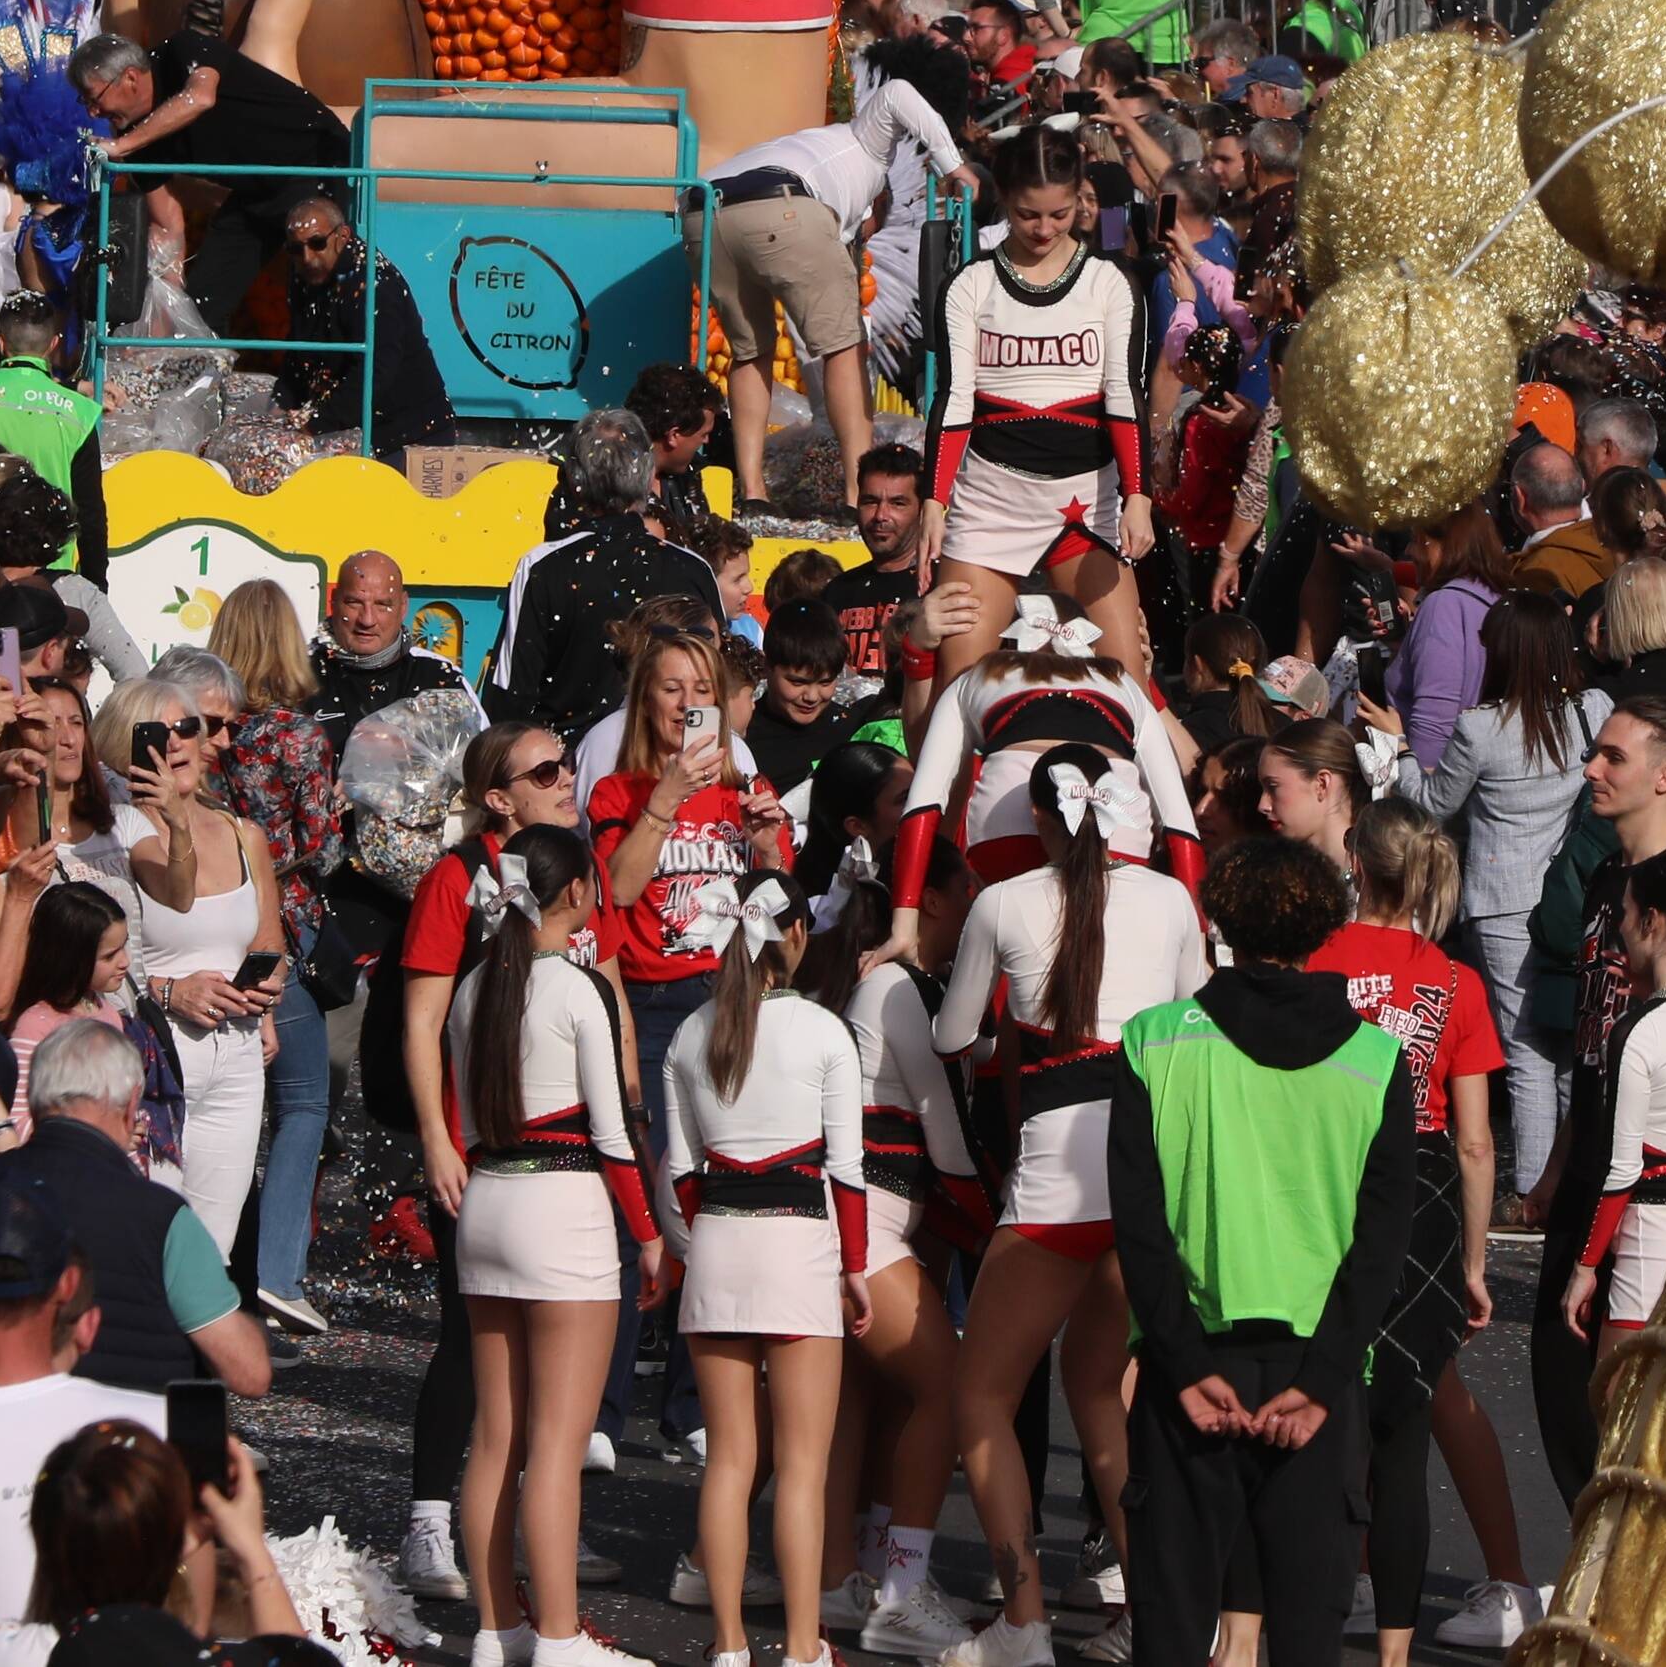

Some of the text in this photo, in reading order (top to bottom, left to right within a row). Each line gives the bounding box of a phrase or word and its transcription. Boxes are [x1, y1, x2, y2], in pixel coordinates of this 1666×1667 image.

[474, 265, 526, 290] FÊTE
[506, 301, 536, 319] DU
[489, 332, 571, 352] CITRON
[979, 328, 1100, 368] MONACO
[190, 536, 211, 576] 1
[1070, 784, 1112, 806] MONACO
[716, 901, 762, 922] MONACO
[1347, 974, 1394, 998] HITE
[1377, 1003, 1421, 1036] RED
